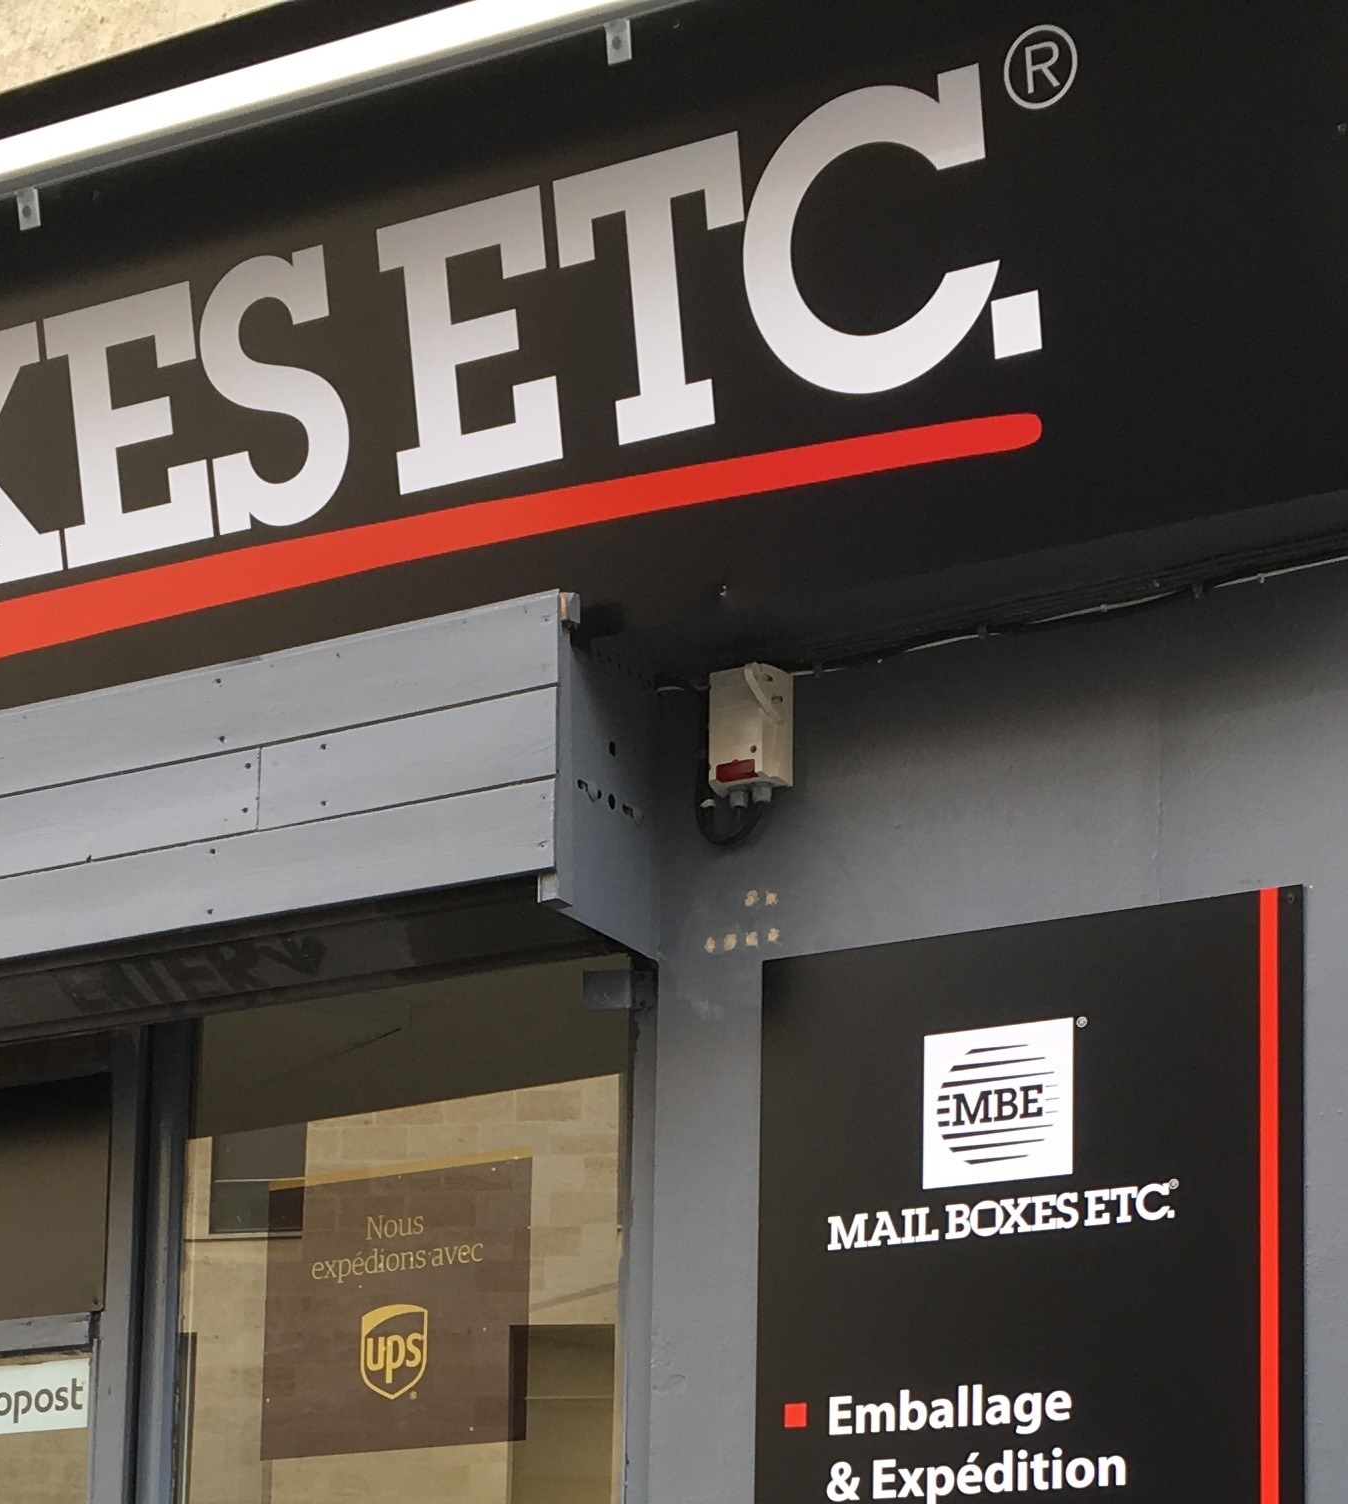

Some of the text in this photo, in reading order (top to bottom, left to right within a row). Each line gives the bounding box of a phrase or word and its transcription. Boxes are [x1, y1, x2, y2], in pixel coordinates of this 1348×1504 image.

[376, 62, 1043, 495] ETC.
[951, 1084, 1044, 1127] MBE
[366, 1214, 425, 1241] Nous
[827, 1183, 1175, 1251] MAIL BOXES ETC.
[311, 1240, 484, 1285] expédions avec
[366, 1332, 423, 1384] ups
[828, 1384, 1073, 1435] Emballage
[826, 1461, 860, 1502] &
